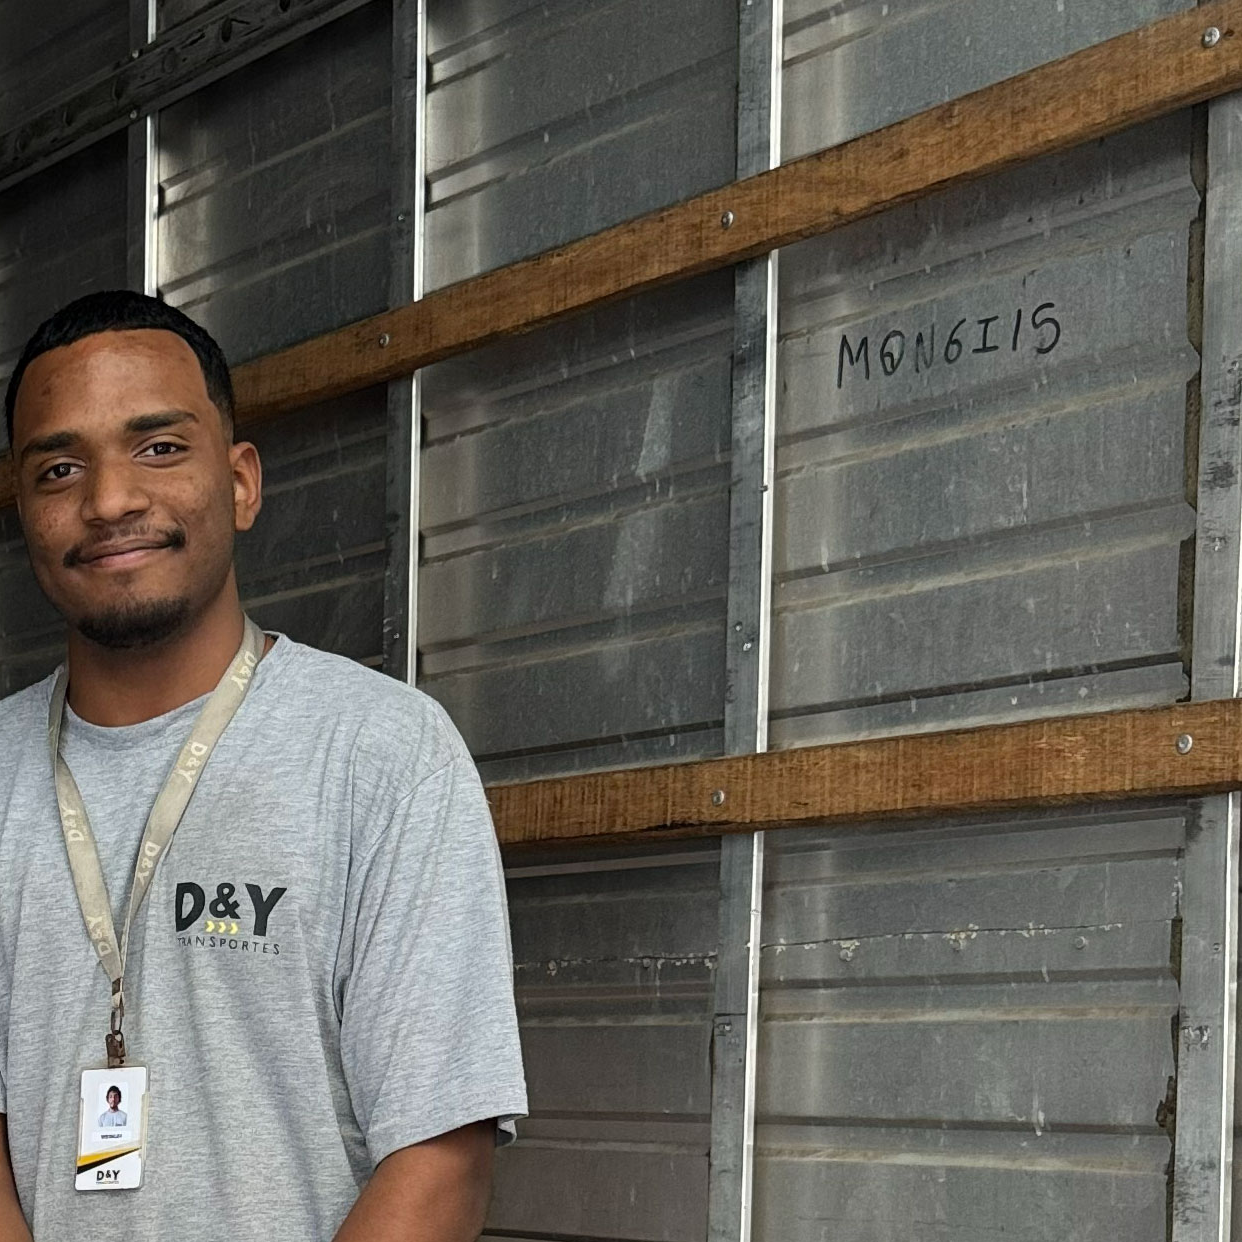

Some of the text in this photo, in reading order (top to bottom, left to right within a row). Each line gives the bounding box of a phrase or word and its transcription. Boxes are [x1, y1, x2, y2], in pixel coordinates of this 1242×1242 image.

[230, 650, 257, 691] D&Y
[175, 741, 208, 783] D&Y
[61, 806, 85, 842] D&Y
[137, 841, 161, 886] D&Y
[175, 882, 288, 937] D&Y
[85, 915, 112, 957] D&Y
[178, 936, 281, 955] TRANSPORTES
[96, 1169, 121, 1182] D&Y
